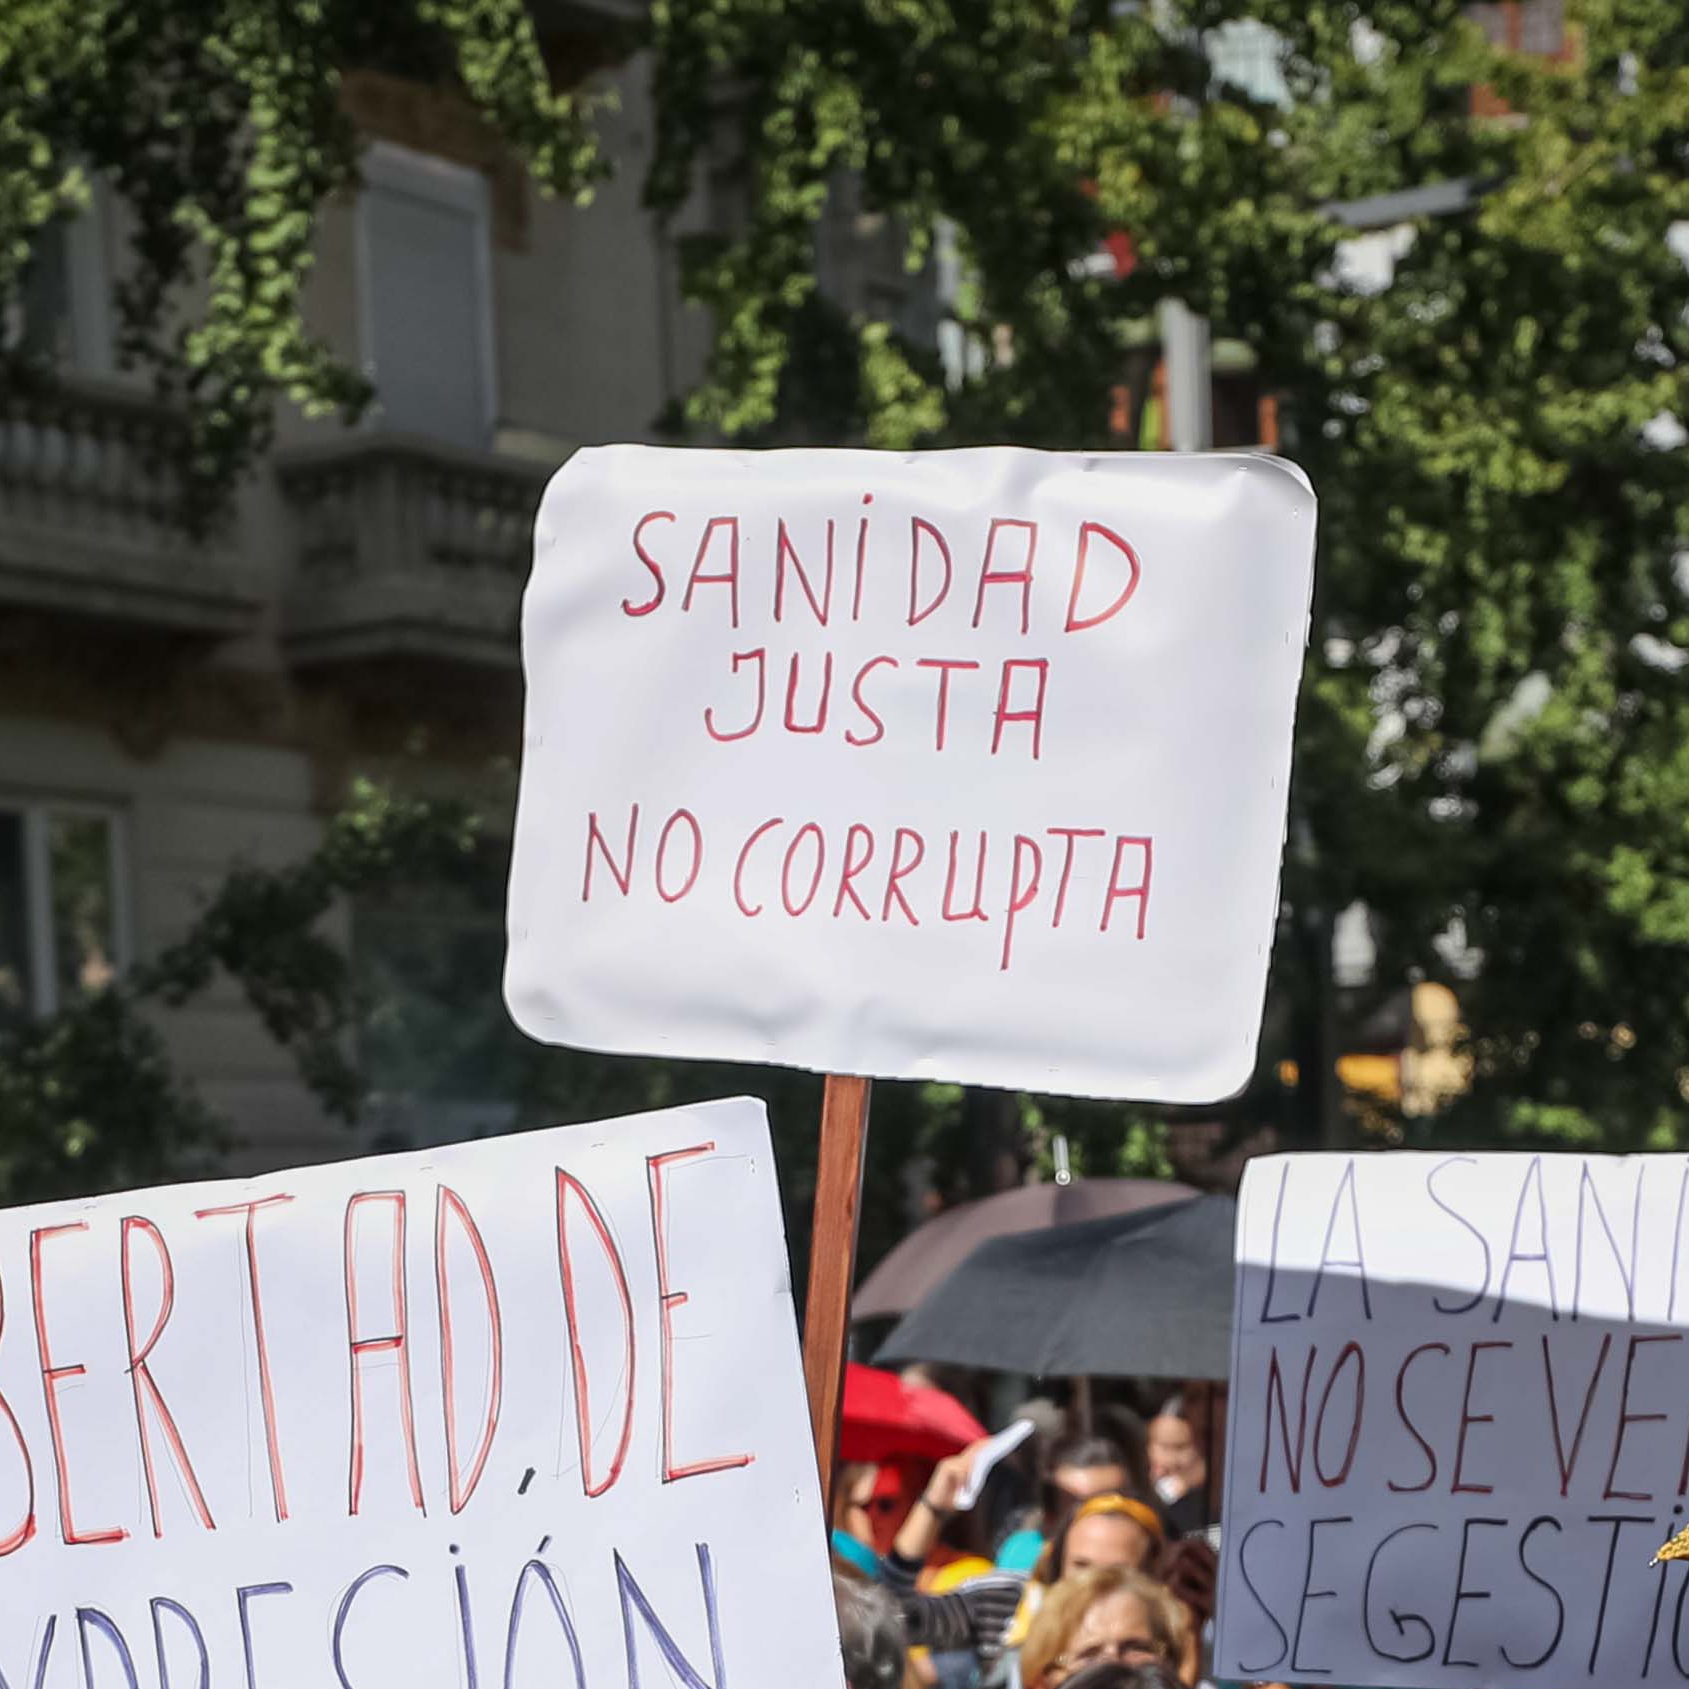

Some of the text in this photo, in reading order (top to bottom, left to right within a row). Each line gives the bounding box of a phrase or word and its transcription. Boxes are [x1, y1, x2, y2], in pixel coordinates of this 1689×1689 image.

[704, 647, 1050, 761] JUSTA
[582, 803, 1154, 972] NO CORRUPTA
[556, 1142, 757, 1498] DE
[1260, 1157, 1373, 1324] LA
[1259, 1338, 1366, 1495] NO
[1387, 1340, 1513, 1495] SE
[1238, 1516, 1354, 1675] SE
